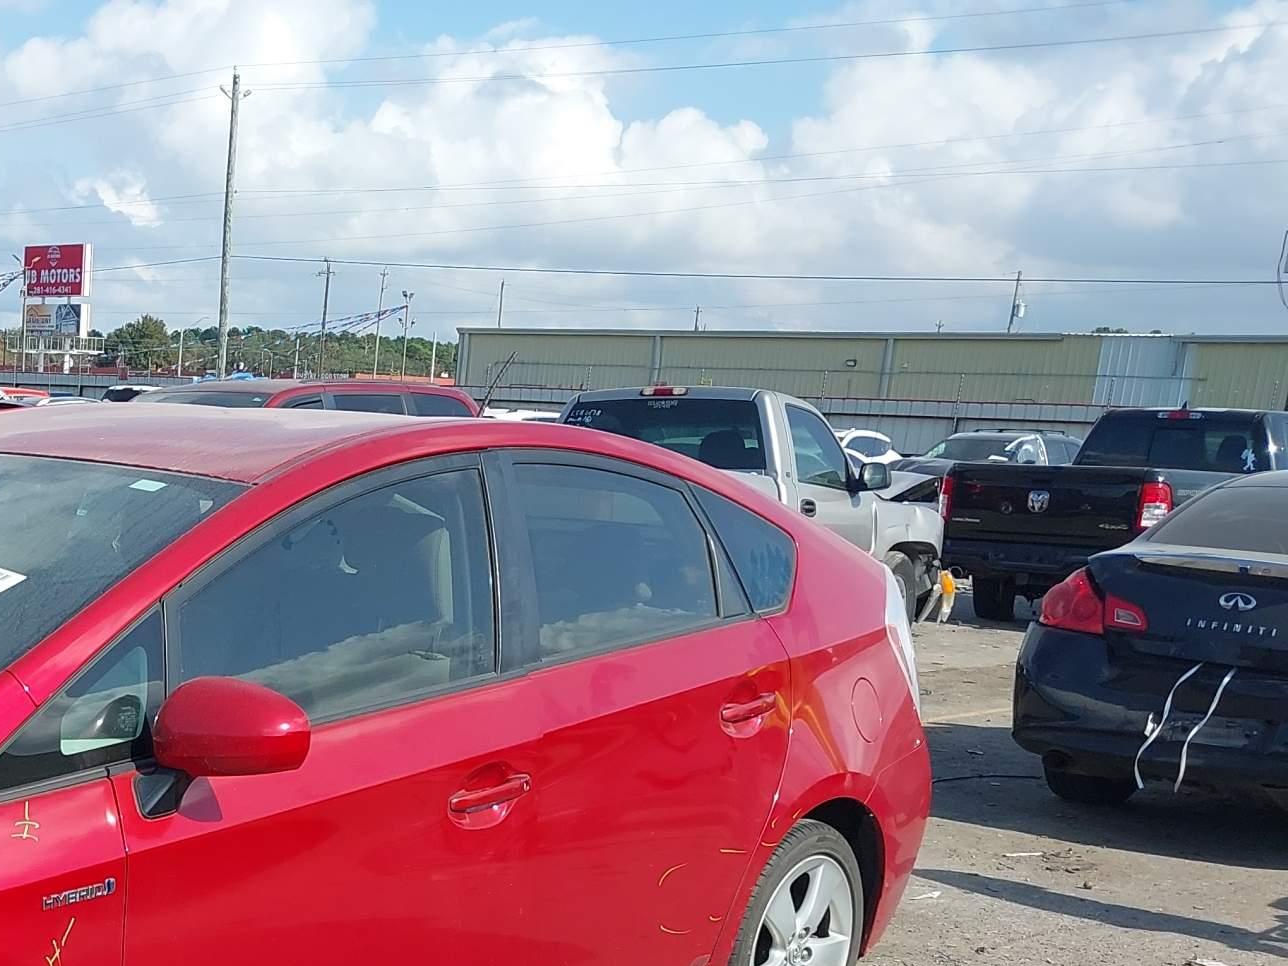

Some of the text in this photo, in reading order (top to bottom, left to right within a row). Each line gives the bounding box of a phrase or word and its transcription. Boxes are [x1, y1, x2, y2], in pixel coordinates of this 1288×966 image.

[40, 268, 81, 284] MOTORS
[1186, 617, 1278, 637] INFINITI
[42, 883, 106, 911] HYBRID
